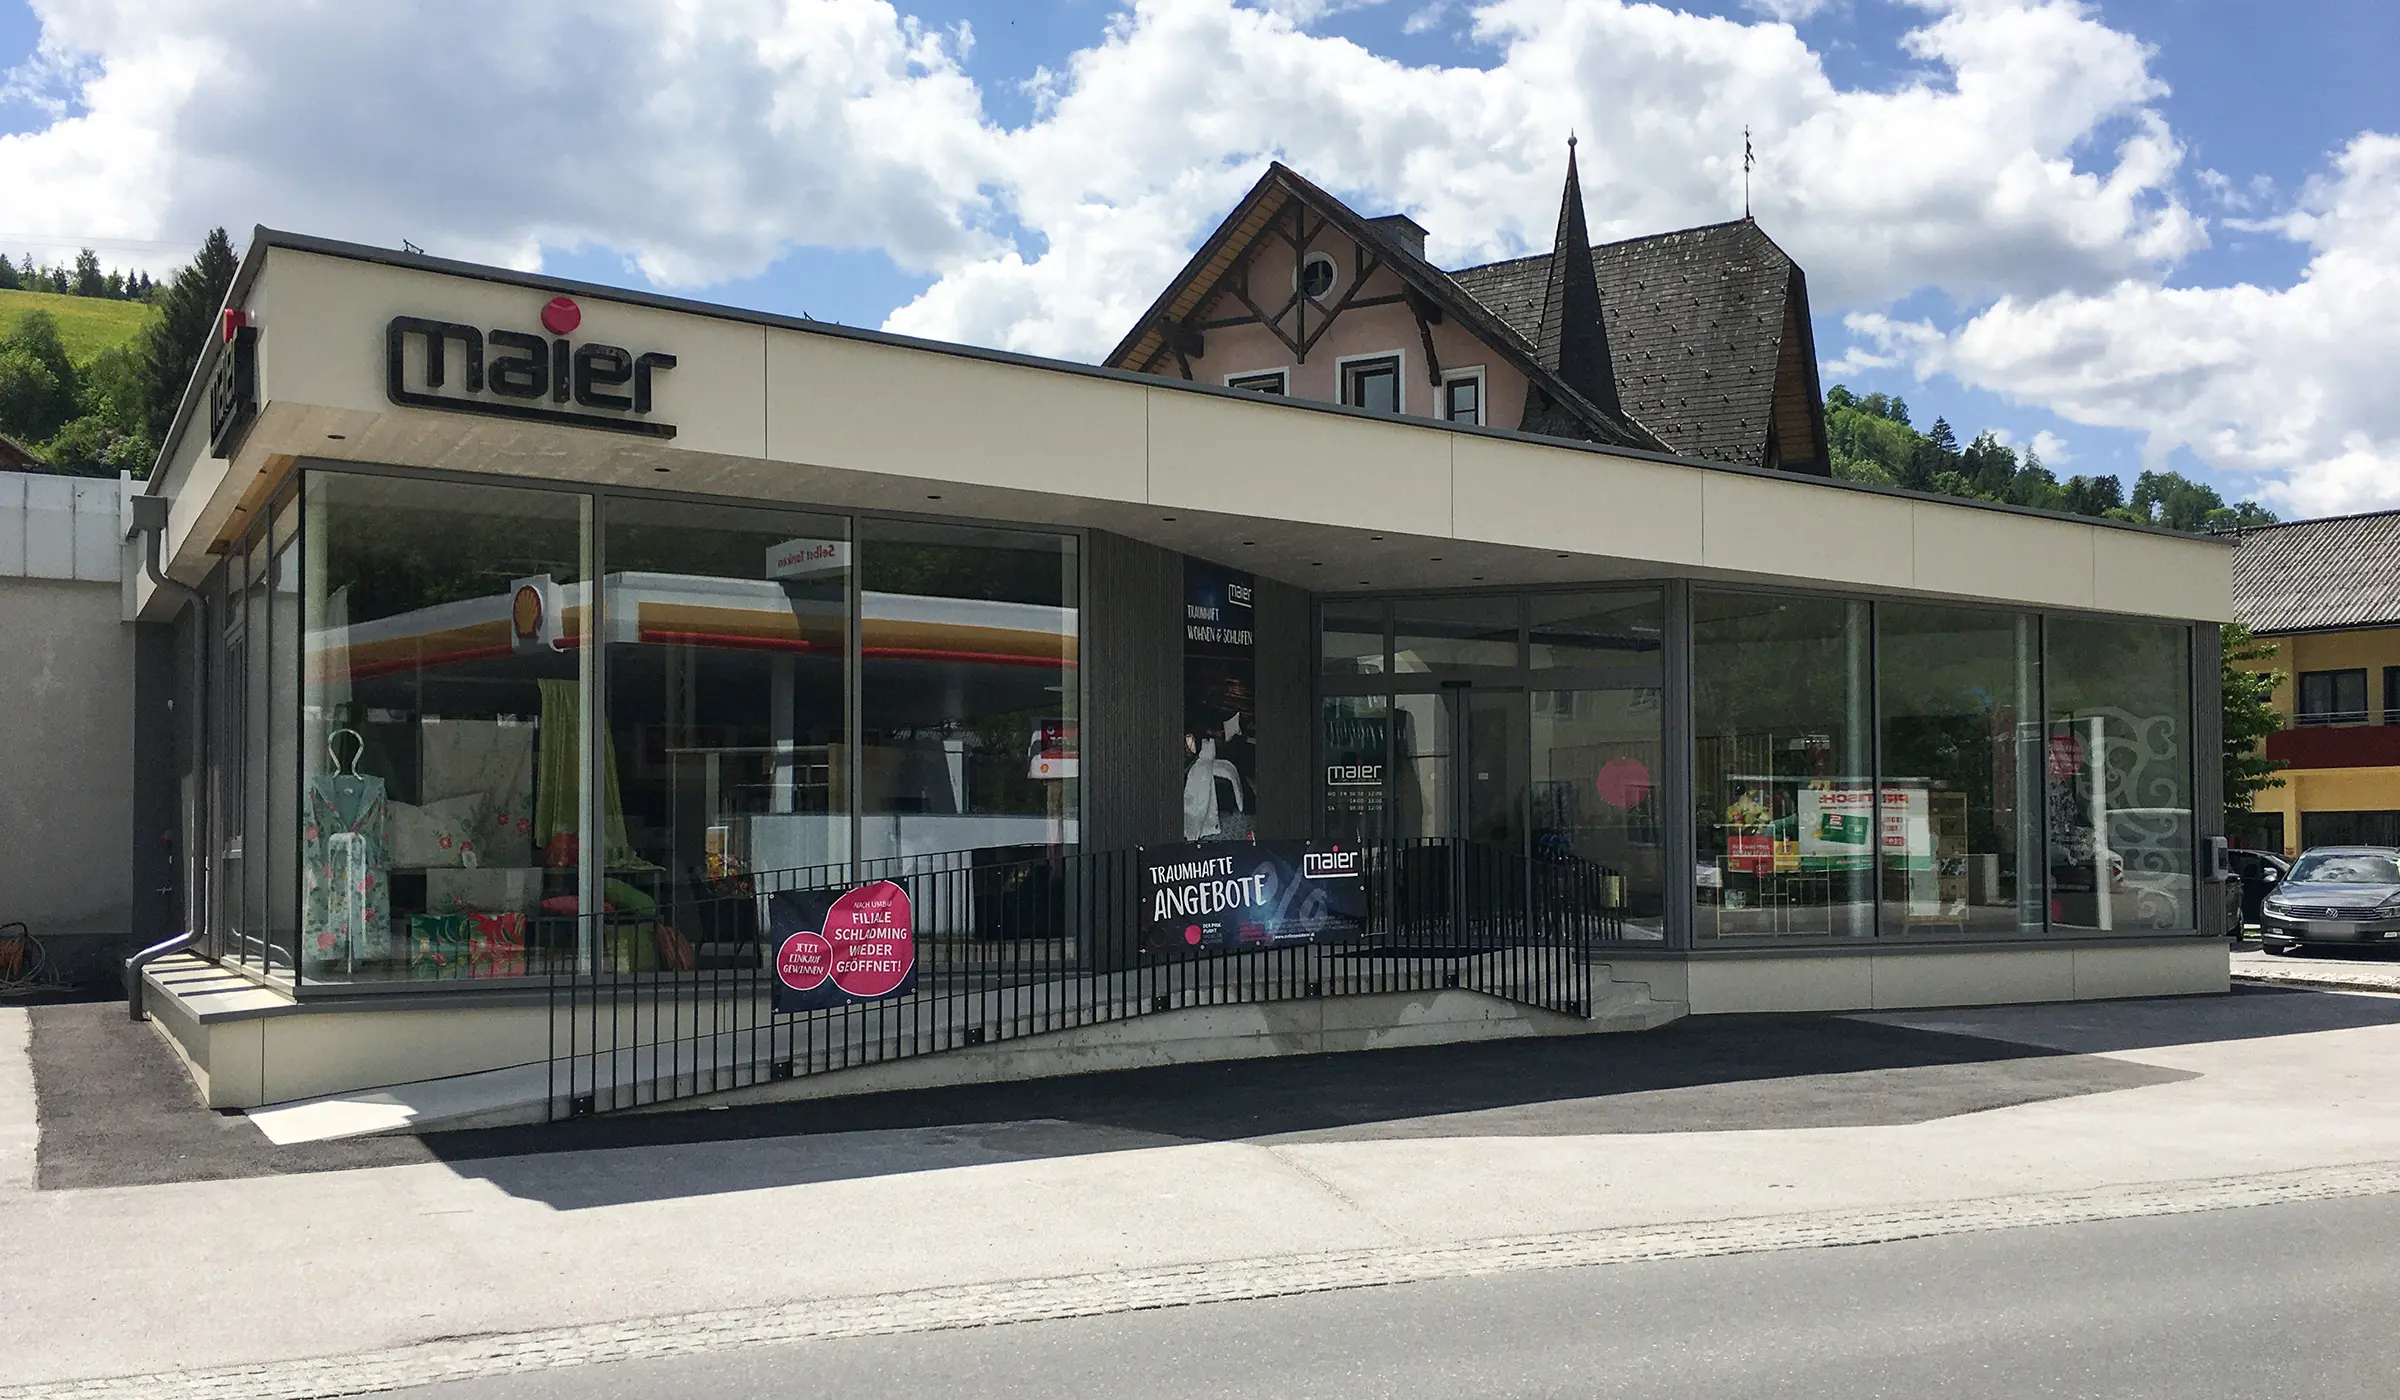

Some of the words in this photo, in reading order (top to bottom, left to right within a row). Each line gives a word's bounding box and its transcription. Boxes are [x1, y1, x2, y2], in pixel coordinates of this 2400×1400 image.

[386, 295, 677, 440] maier
[1228, 582, 1252, 608] maier
[1187, 605, 1219, 621] TRAUMHAFT
[1187, 625, 1215, 642] WOHNEN
[1215, 628, 1222, 642] &
[1223, 628, 1253, 645] SCHLAFEN
[1327, 759, 1382, 785] maier
[1303, 844, 1359, 879] maier
[1149, 856, 1234, 885] TRAUMHAFTE
[853, 901, 870, 909] NACH
[1153, 874, 1267, 922] ANGEBOTE
[852, 911, 892, 925] FILIALE
[834, 927, 908, 941] SCHLADMING
[796, 943, 819, 953] JETZT
[849, 944, 893, 957] WIEDER
[789, 954, 821, 963] EINKAUF
[836, 958, 902, 973] GEÖFFNET!
